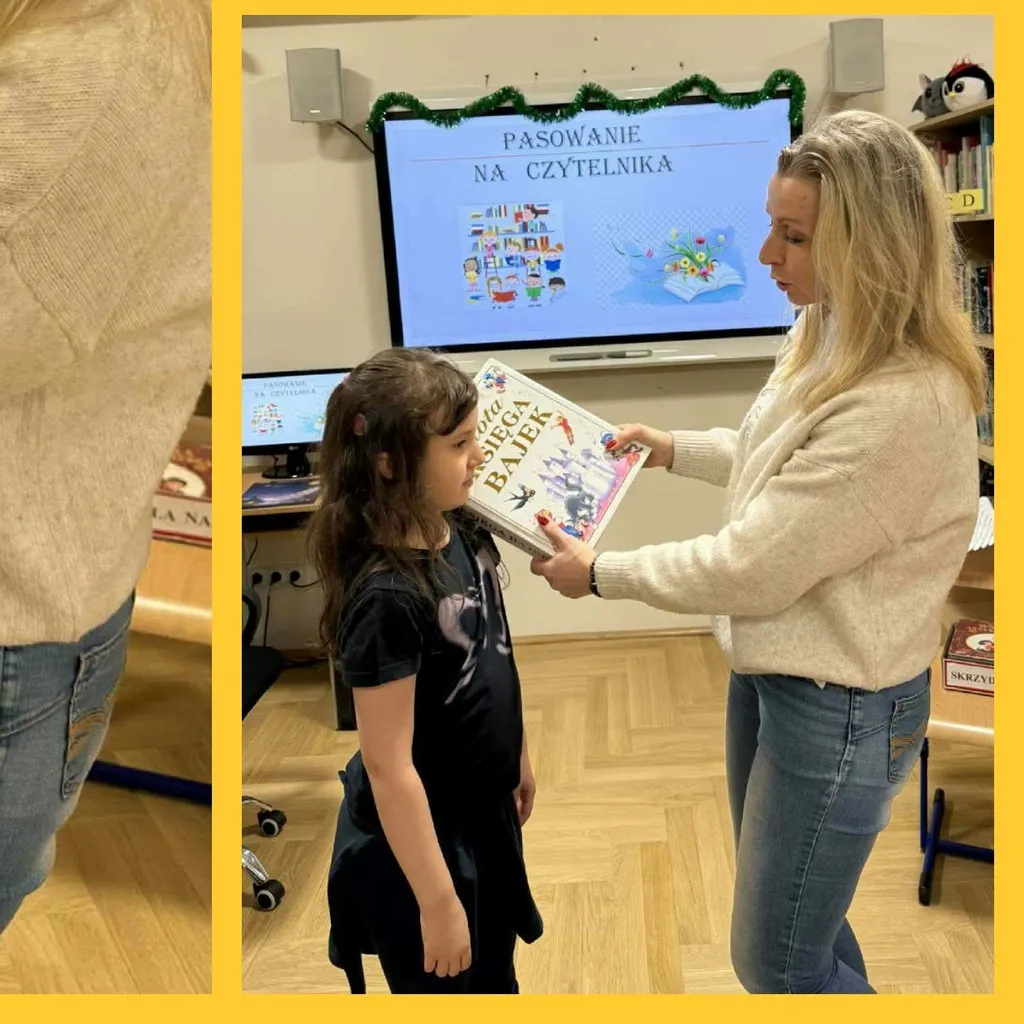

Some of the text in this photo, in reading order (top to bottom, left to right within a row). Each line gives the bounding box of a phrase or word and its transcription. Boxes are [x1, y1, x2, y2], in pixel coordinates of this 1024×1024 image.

[503, 125, 643, 151] PASOWANIE
[474, 155, 674, 184] NA CZYTELNIKA
[963, 194, 975, 207] D
[484, 406, 553, 494] BAJEK
